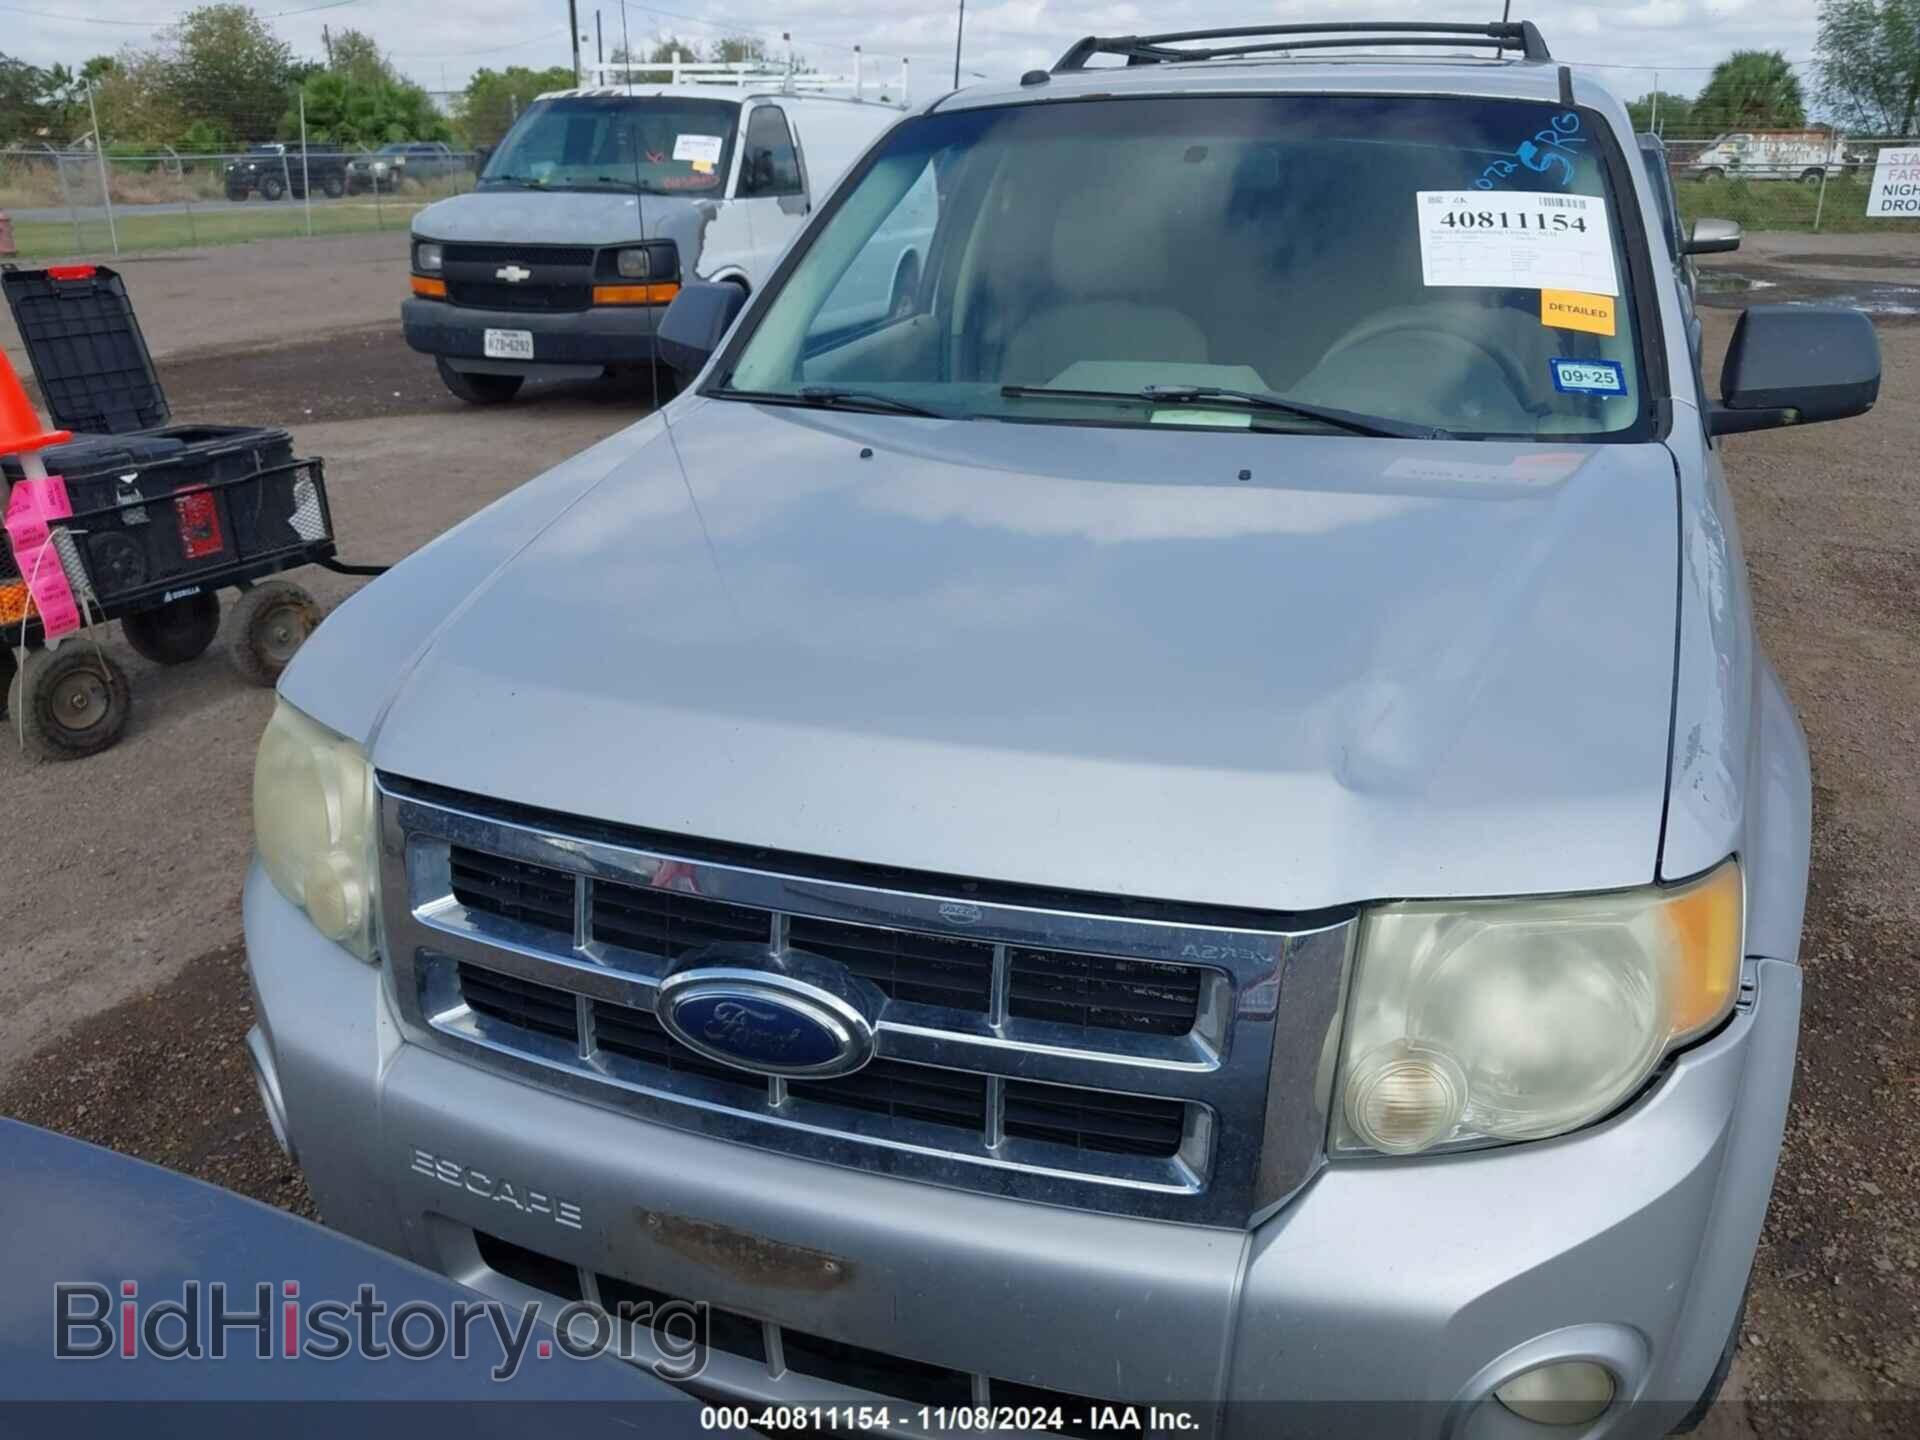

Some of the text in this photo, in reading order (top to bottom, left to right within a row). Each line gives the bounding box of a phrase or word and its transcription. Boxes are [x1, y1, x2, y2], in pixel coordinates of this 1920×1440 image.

[1881, 200, 1920, 211] DRO
[1440, 210, 1588, 233] 40811154
[1548, 302, 1608, 318] DETAILED
[703, 1002, 801, 1044] Ford
[408, 1144, 583, 1230] ESCAPE
